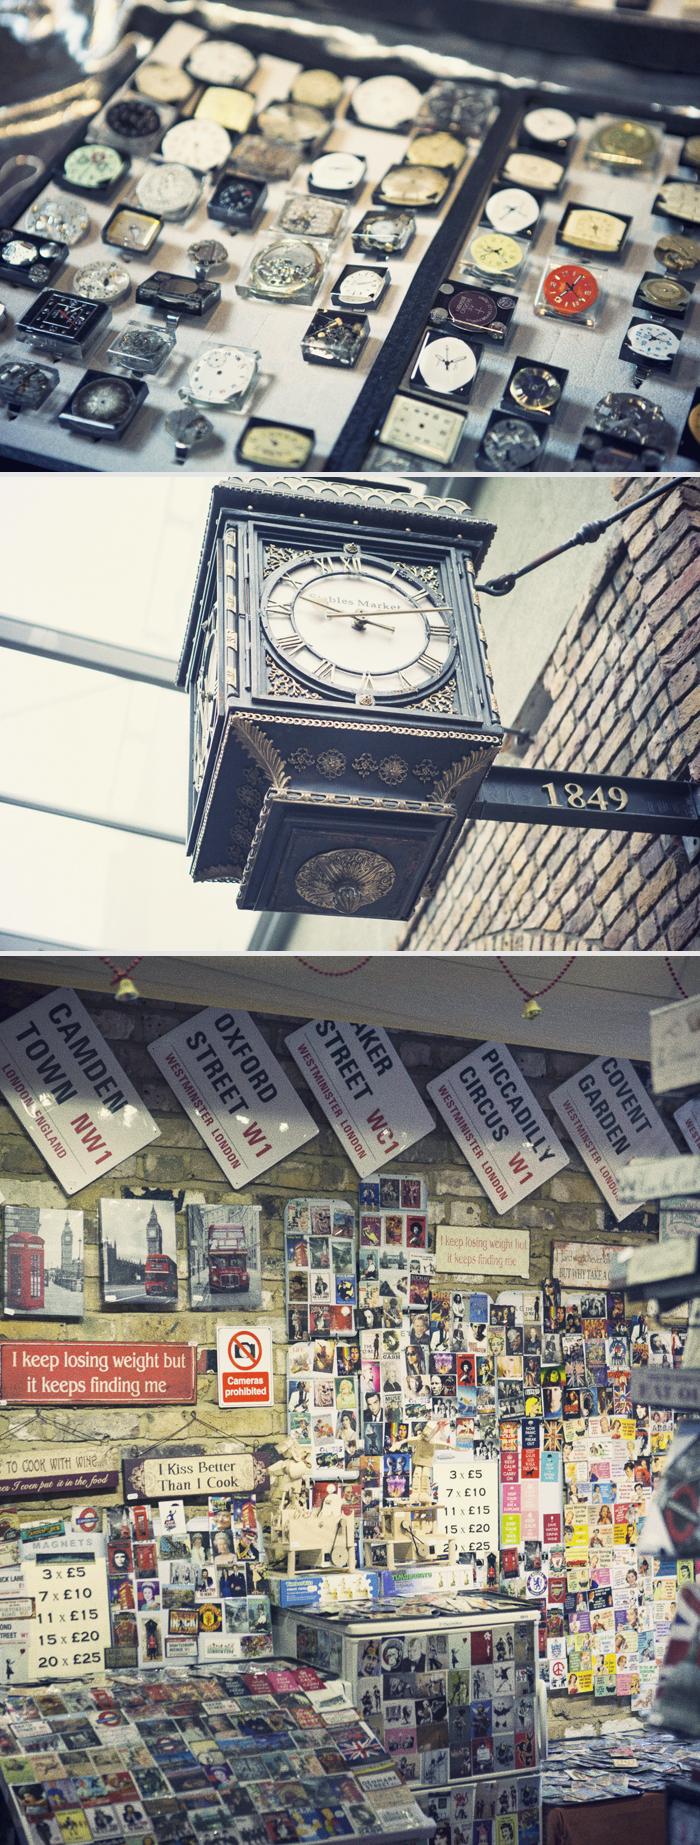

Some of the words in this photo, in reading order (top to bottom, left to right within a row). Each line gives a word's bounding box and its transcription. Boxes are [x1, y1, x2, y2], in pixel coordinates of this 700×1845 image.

[542, 782, 628, 811] 1849
[48, 1002, 128, 1115] CAMDEN
[214, 1013, 278, 1104] OXFORD
[350, 1023, 393, 1077] AKER
[2, 1063, 33, 1108] LONDON
[16, 1021, 79, 1105] TOWN
[70, 1112, 112, 1165] NW1
[186, 1031, 250, 1116] STREET
[243, 1121, 273, 1158] W1
[316, 1020, 373, 1100] STREET
[366, 1108, 400, 1154] WC1
[602, 1056, 652, 1133] COVENT
[166, 1052, 212, 1127] WESTMINSTER
[212, 1128, 240, 1170] LONDON
[481, 1048, 555, 1163] PICCADILLY
[578, 1074, 631, 1155] GARDEN
[459, 1065, 509, 1142] CIRCUS
[508, 1151, 533, 1185] W1
[562, 1100, 601, 1165] WESTMINSTER
[340, 1120, 367, 1159] LONDON
[481, 1160, 509, 1201] LONDON
[446, 1235, 463, 1249] keep
[466, 1236, 487, 1251] losing
[489, 1238, 513, 1251] weight
[448, 1253, 452, 1264] it
[454, 1254, 476, 1266] keeps
[478, 1254, 502, 1268] finding
[12, 1352, 17, 1368] I
[22, 1351, 60, 1371] keep
[64, 1352, 109, 1372] losing
[113, 1352, 160, 1372] weight
[164, 1352, 186, 1368] but
[26, 1376, 36, 1392] it
[42, 1376, 86, 1396] keeps
[90, 1376, 140, 1396] finding
[144, 1380, 166, 1393] me
[227, 1376, 264, 1385] Cameras
[225, 1386, 267, 1398] prohibited
[6, 1460, 18, 1474] TO
[22, 1458, 46, 1473] COOK
[50, 1457, 71, 1471] WITH
[158, 1463, 163, 1475] I
[167, 1462, 193, 1474] Kiss
[198, 1461, 235, 1473] Better
[450, 1470, 457, 1479] 3
[468, 1470, 482, 1478] £5
[20, 1483, 40, 1491] even
[38, 1481, 53, 1492] put
[57, 1480, 64, 1488] it
[75, 1476, 87, 1486] the
[86, 1474, 109, 1488] food
[158, 1478, 191, 1492] Than
[197, 1477, 202, 1489] I
[207, 1475, 240, 1488] Cook
[446, 1489, 453, 1497] 7
[464, 1488, 486, 1497] £10
[444, 1506, 455, 1516] 11
[469, 1506, 490, 1515] £15
[445, 1525, 458, 1534] 15
[469, 1524, 490, 1532] £20
[32, 1539, 92, 1549] MAGNETS
[469, 1542, 490, 1551] £25
[42, 1569, 52, 1580] 3
[67, 1567, 85, 1578] £5
[39, 1591, 48, 1602] 7
[64, 1588, 92, 1600] £10
[37, 1612, 52, 1624] 11
[70, 1609, 98, 1621] £15
[39, 1634, 57, 1646] 15
[72, 1631, 99, 1643] £20
[38, 1656, 58, 1668] 20
[73, 1652, 101, 1664] £25
